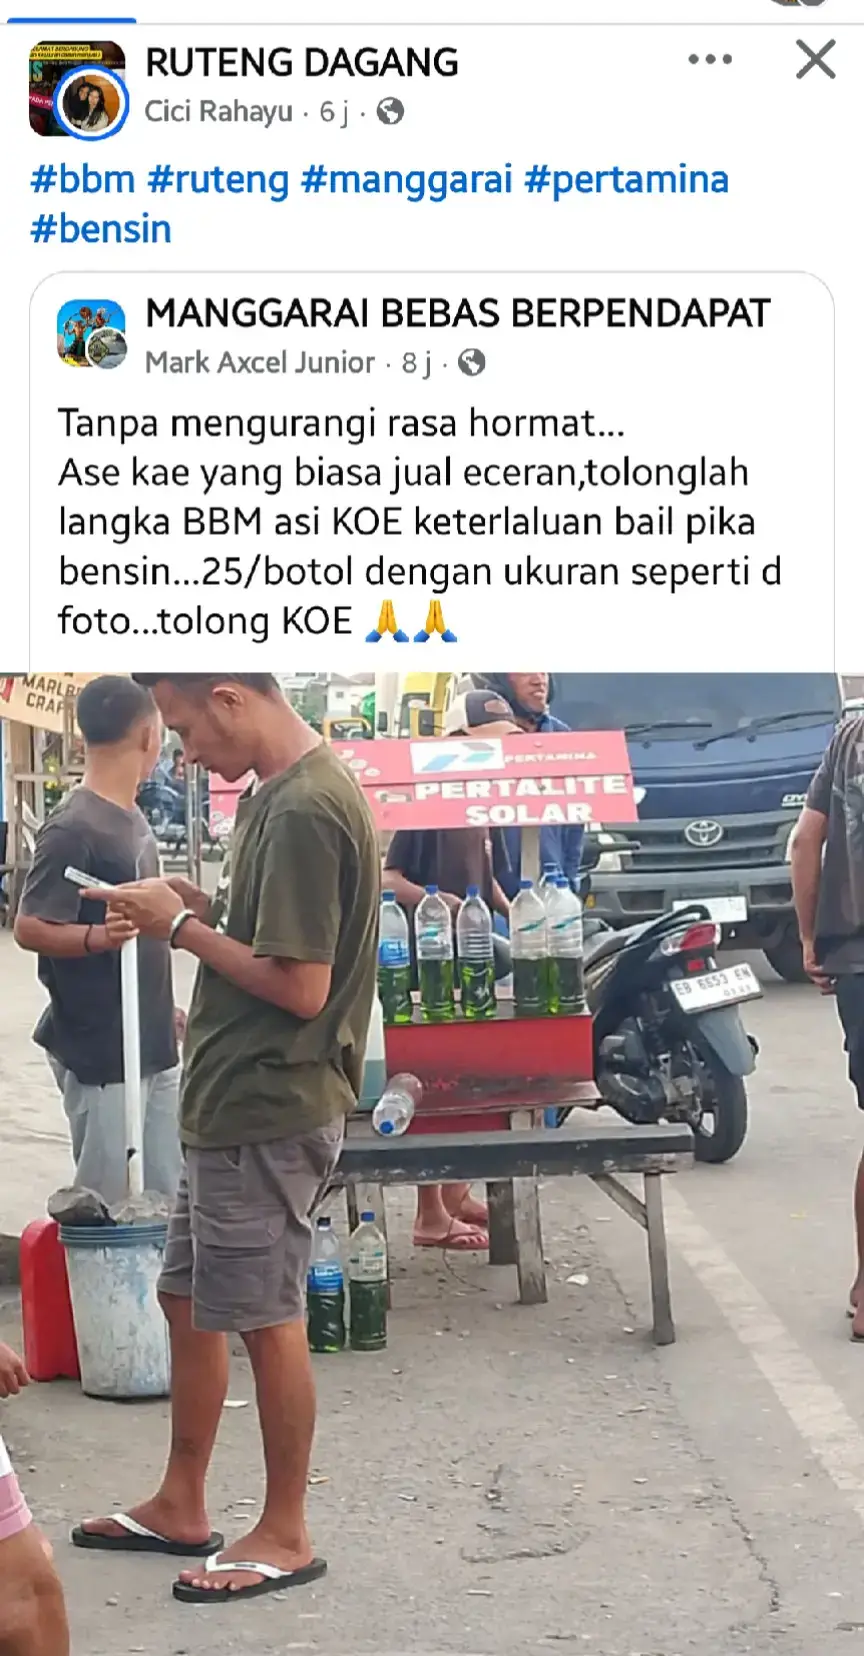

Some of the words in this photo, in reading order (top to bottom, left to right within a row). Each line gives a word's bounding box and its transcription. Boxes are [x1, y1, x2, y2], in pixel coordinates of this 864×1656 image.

[26, 692, 65, 715] CRAF
[504, 751, 597, 764] PERTAMINA
[414, 774, 629, 800] PERTALITE
[465, 802, 593, 826] SOLAR
